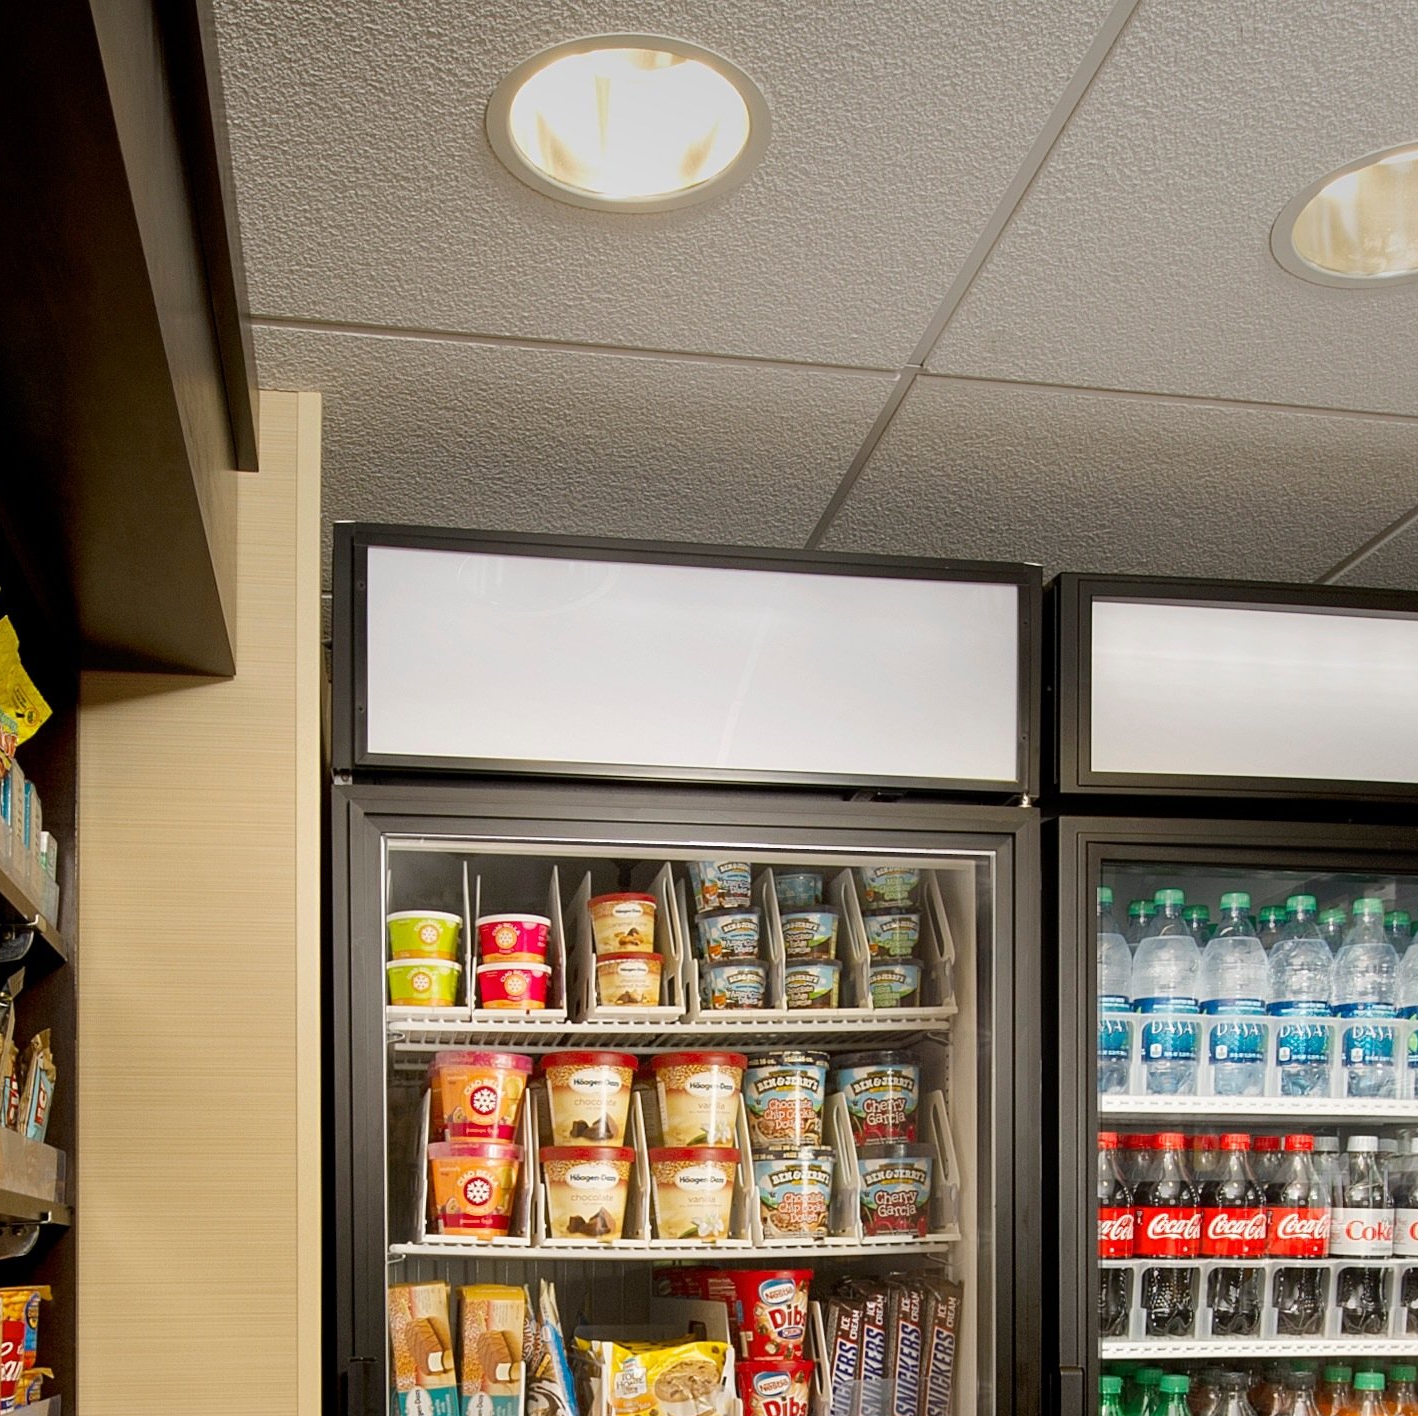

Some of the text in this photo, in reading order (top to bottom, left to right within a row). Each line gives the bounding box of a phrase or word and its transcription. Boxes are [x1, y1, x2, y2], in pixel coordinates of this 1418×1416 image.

[863, 1098, 906, 1115] Cherry
[865, 1112, 906, 1127] Garcia
[874, 1190, 917, 1206] Cherry
[877, 1204, 917, 1218] Garcia
[768, 1305, 807, 1330] Dibs
